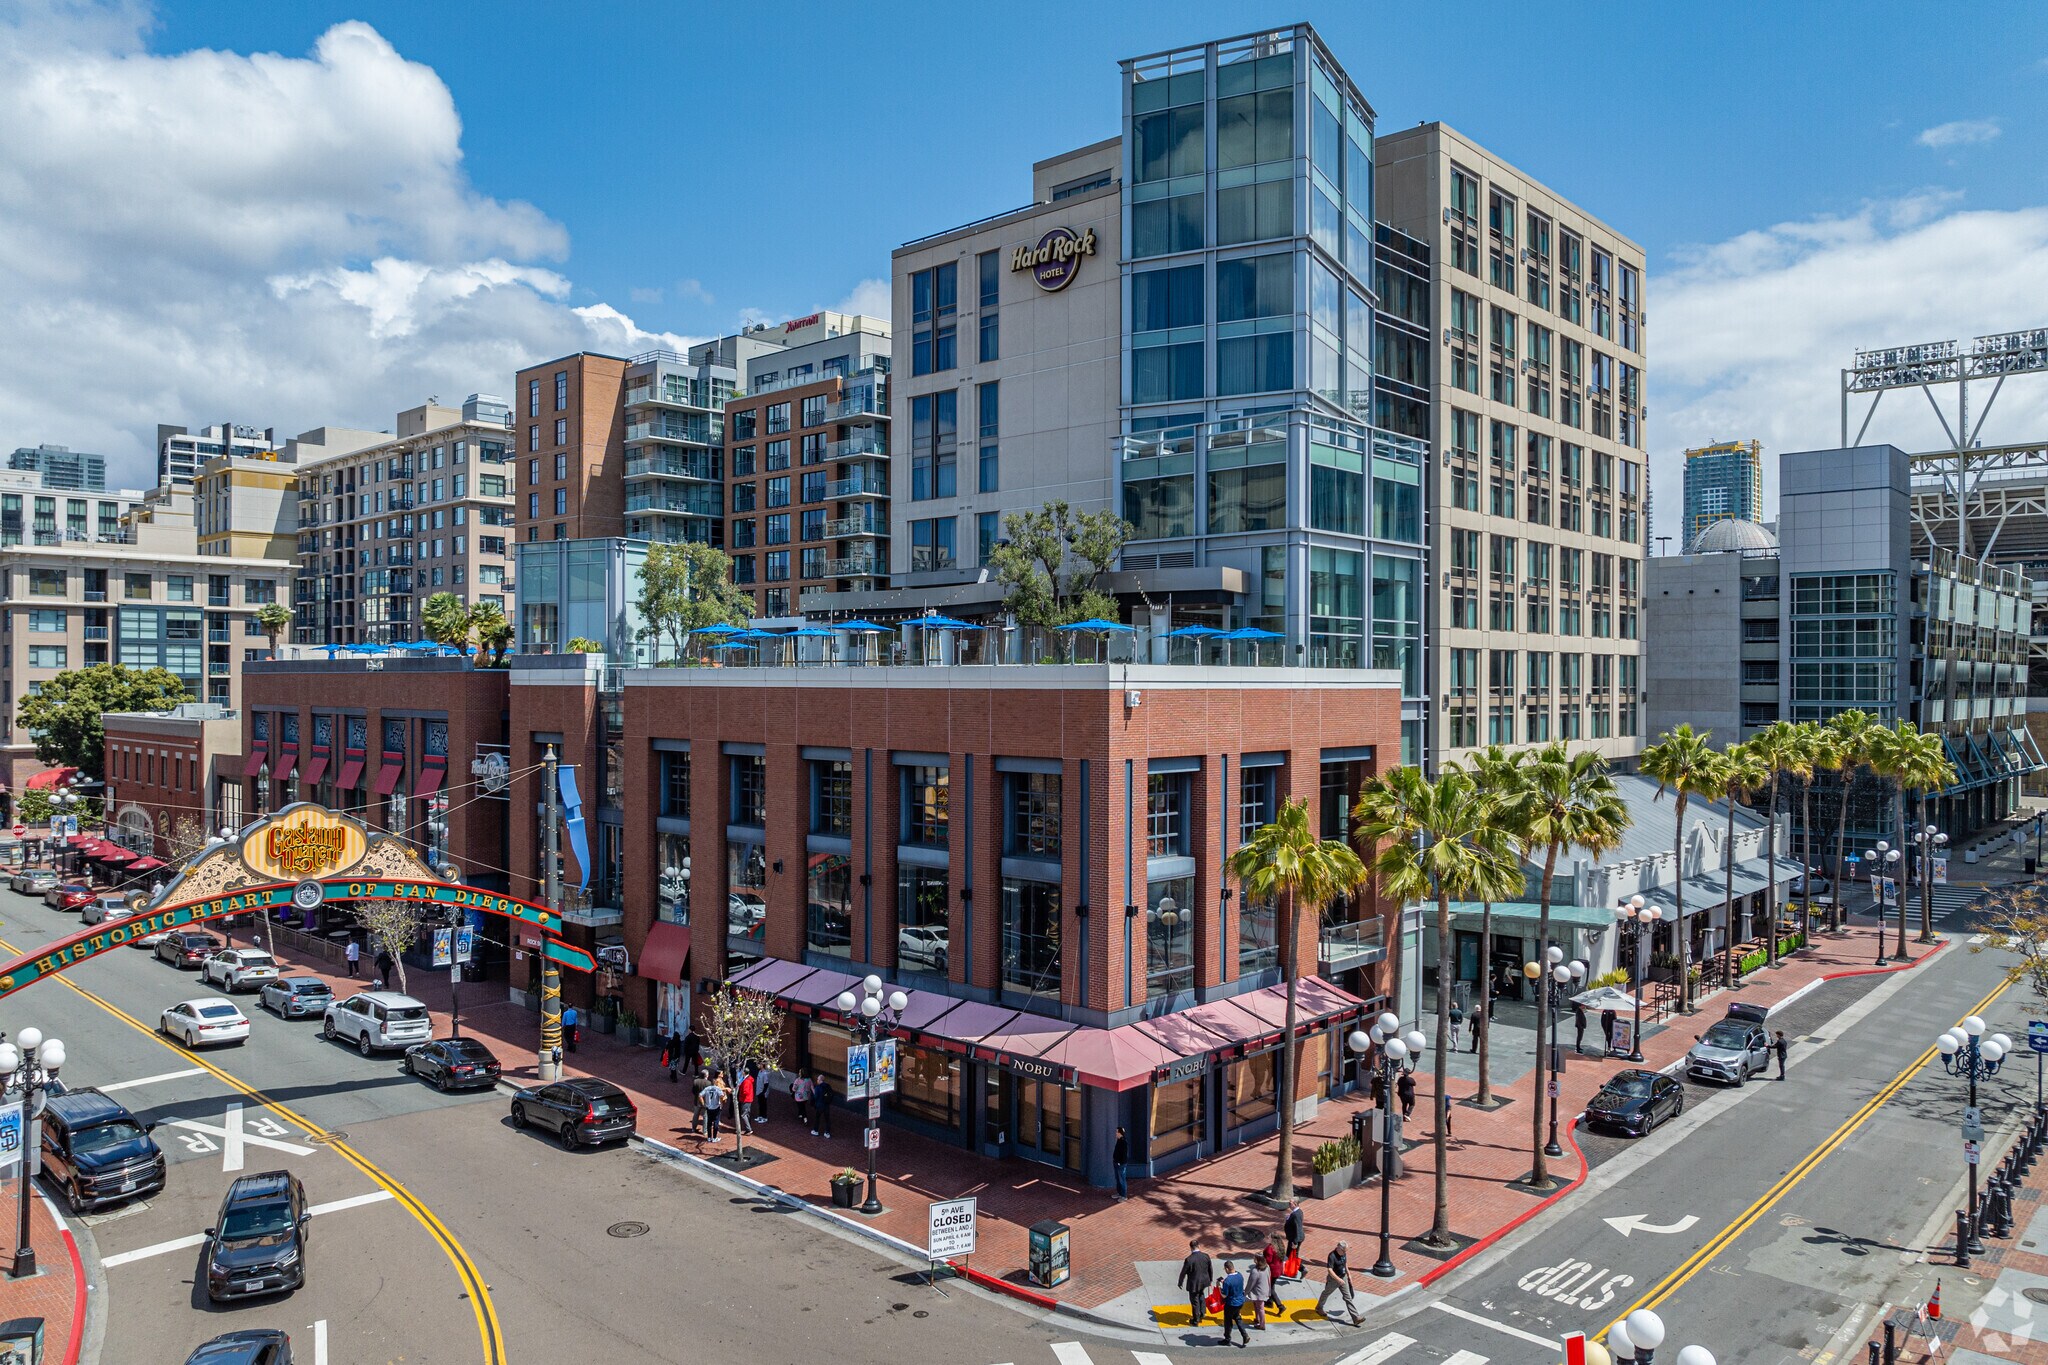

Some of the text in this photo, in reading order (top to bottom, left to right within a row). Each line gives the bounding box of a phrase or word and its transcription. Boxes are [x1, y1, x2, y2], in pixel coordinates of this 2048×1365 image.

[1011, 228, 1096, 272] Hard Rock
[1039, 267, 1065, 280] HOTEL
[785, 313, 819, 334] Marriott
[471, 760, 508, 780] Hard Rock
[267, 819, 346, 860] Gaslamp
[37, 883, 524, 974] HISTORIC HEART OF SAN DIEGO
[1013, 1059, 1053, 1077] NOBU
[1174, 1058, 1208, 1079] NOBU
[933, 1214, 972, 1227] CLOSED
[941, 1206, 964, 1216] 5th AVE
[932, 1226, 955, 1236] BETWEEN
[1517, 1257, 1634, 1311] STOP
